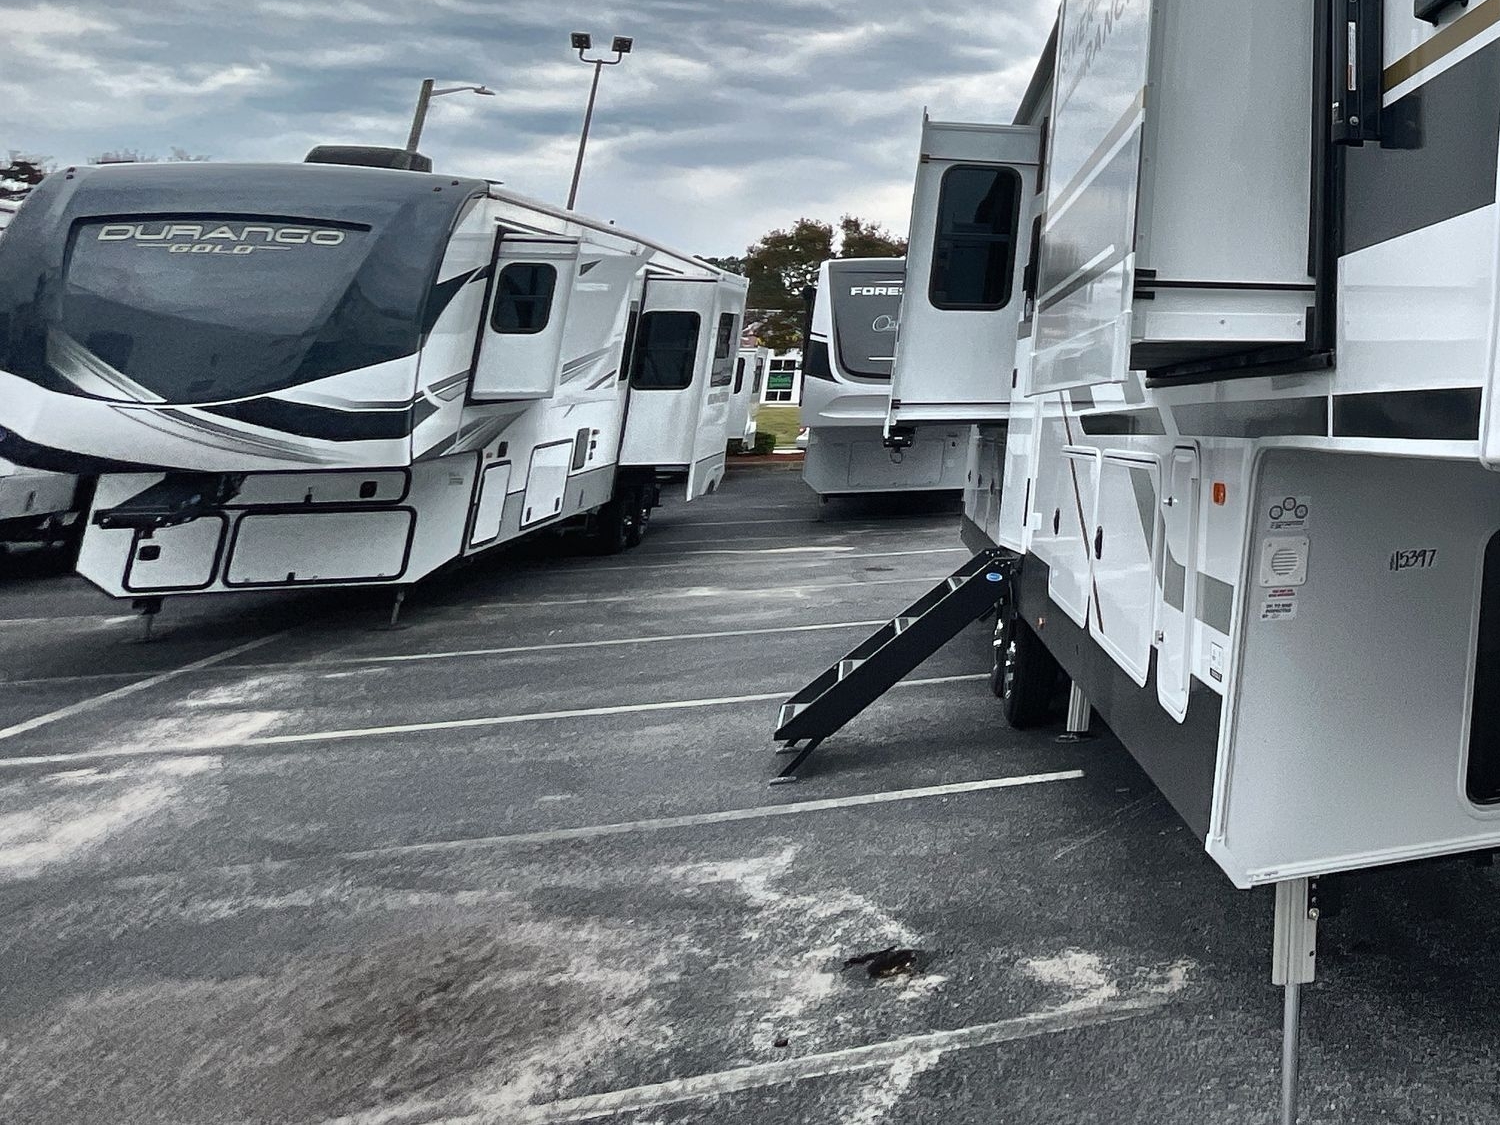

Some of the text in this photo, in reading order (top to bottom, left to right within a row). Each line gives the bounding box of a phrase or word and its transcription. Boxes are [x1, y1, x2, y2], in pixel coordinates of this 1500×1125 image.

[98, 224, 346, 246] DURANGO
[168, 243, 253, 255] GOLD
[1389, 549, 1437, 572] 115397
